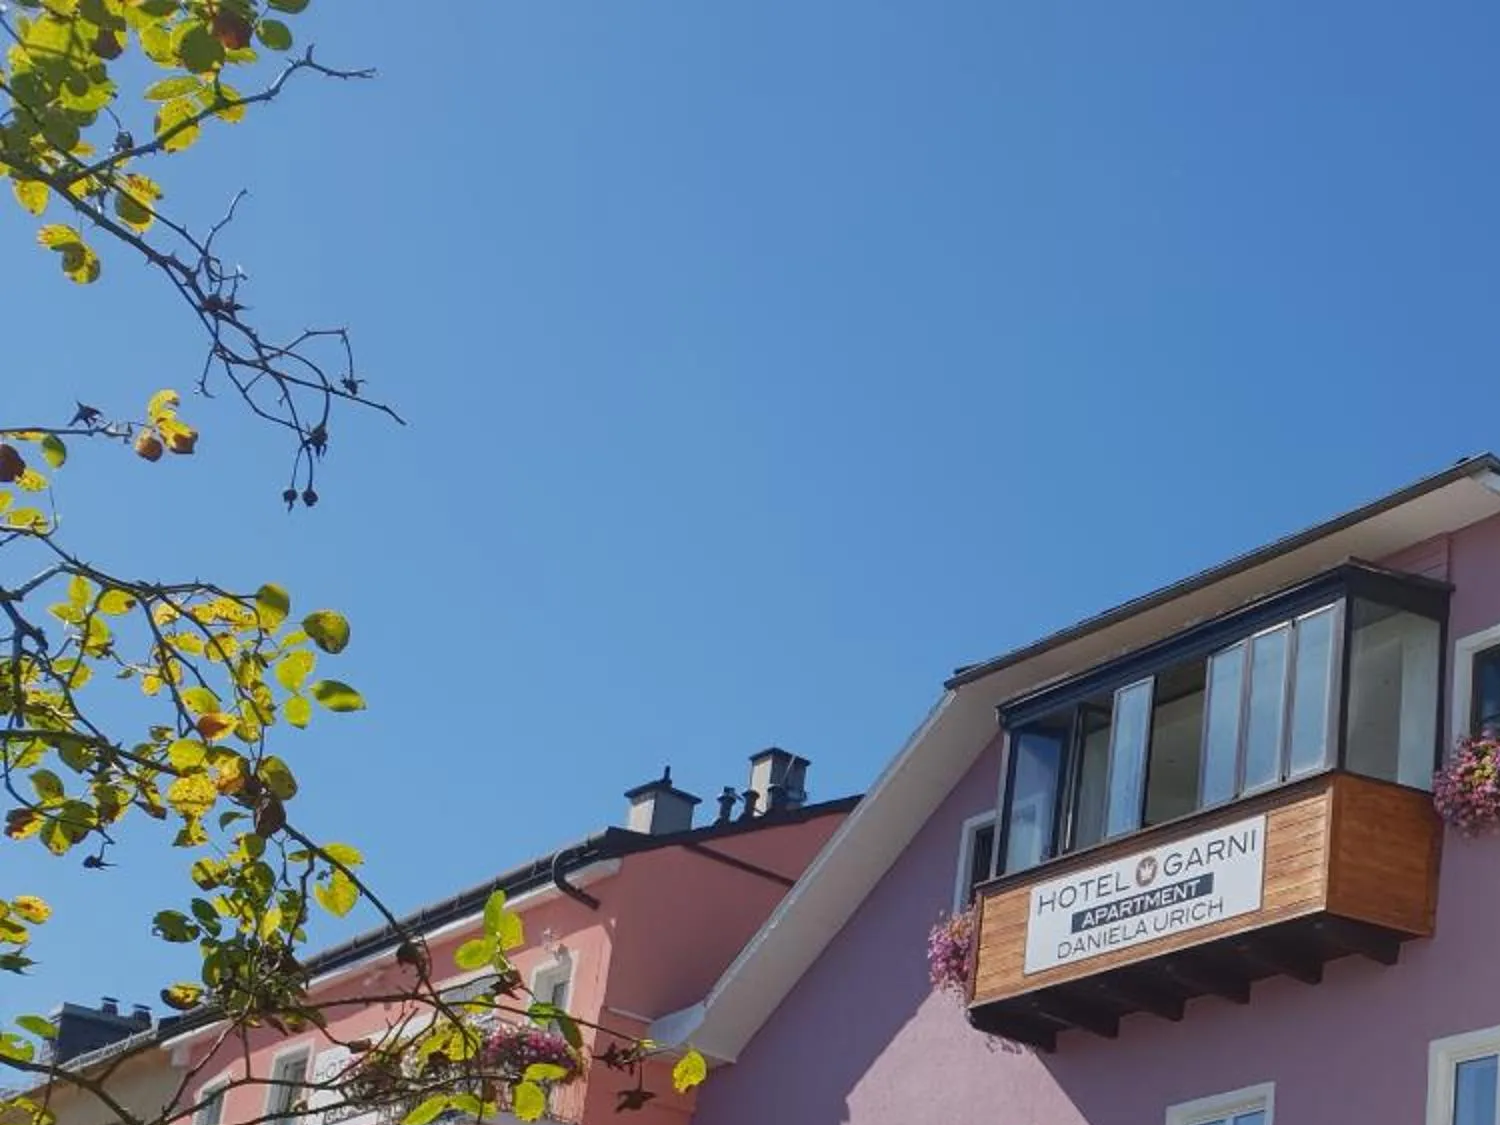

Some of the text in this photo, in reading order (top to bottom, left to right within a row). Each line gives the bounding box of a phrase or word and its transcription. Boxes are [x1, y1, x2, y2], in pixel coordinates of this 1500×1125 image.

[1037, 829, 1257, 916] HOTEL GARNI
[1081, 879, 1201, 929] APARTMENT
[1056, 896, 1224, 960] DANIELA URICH
